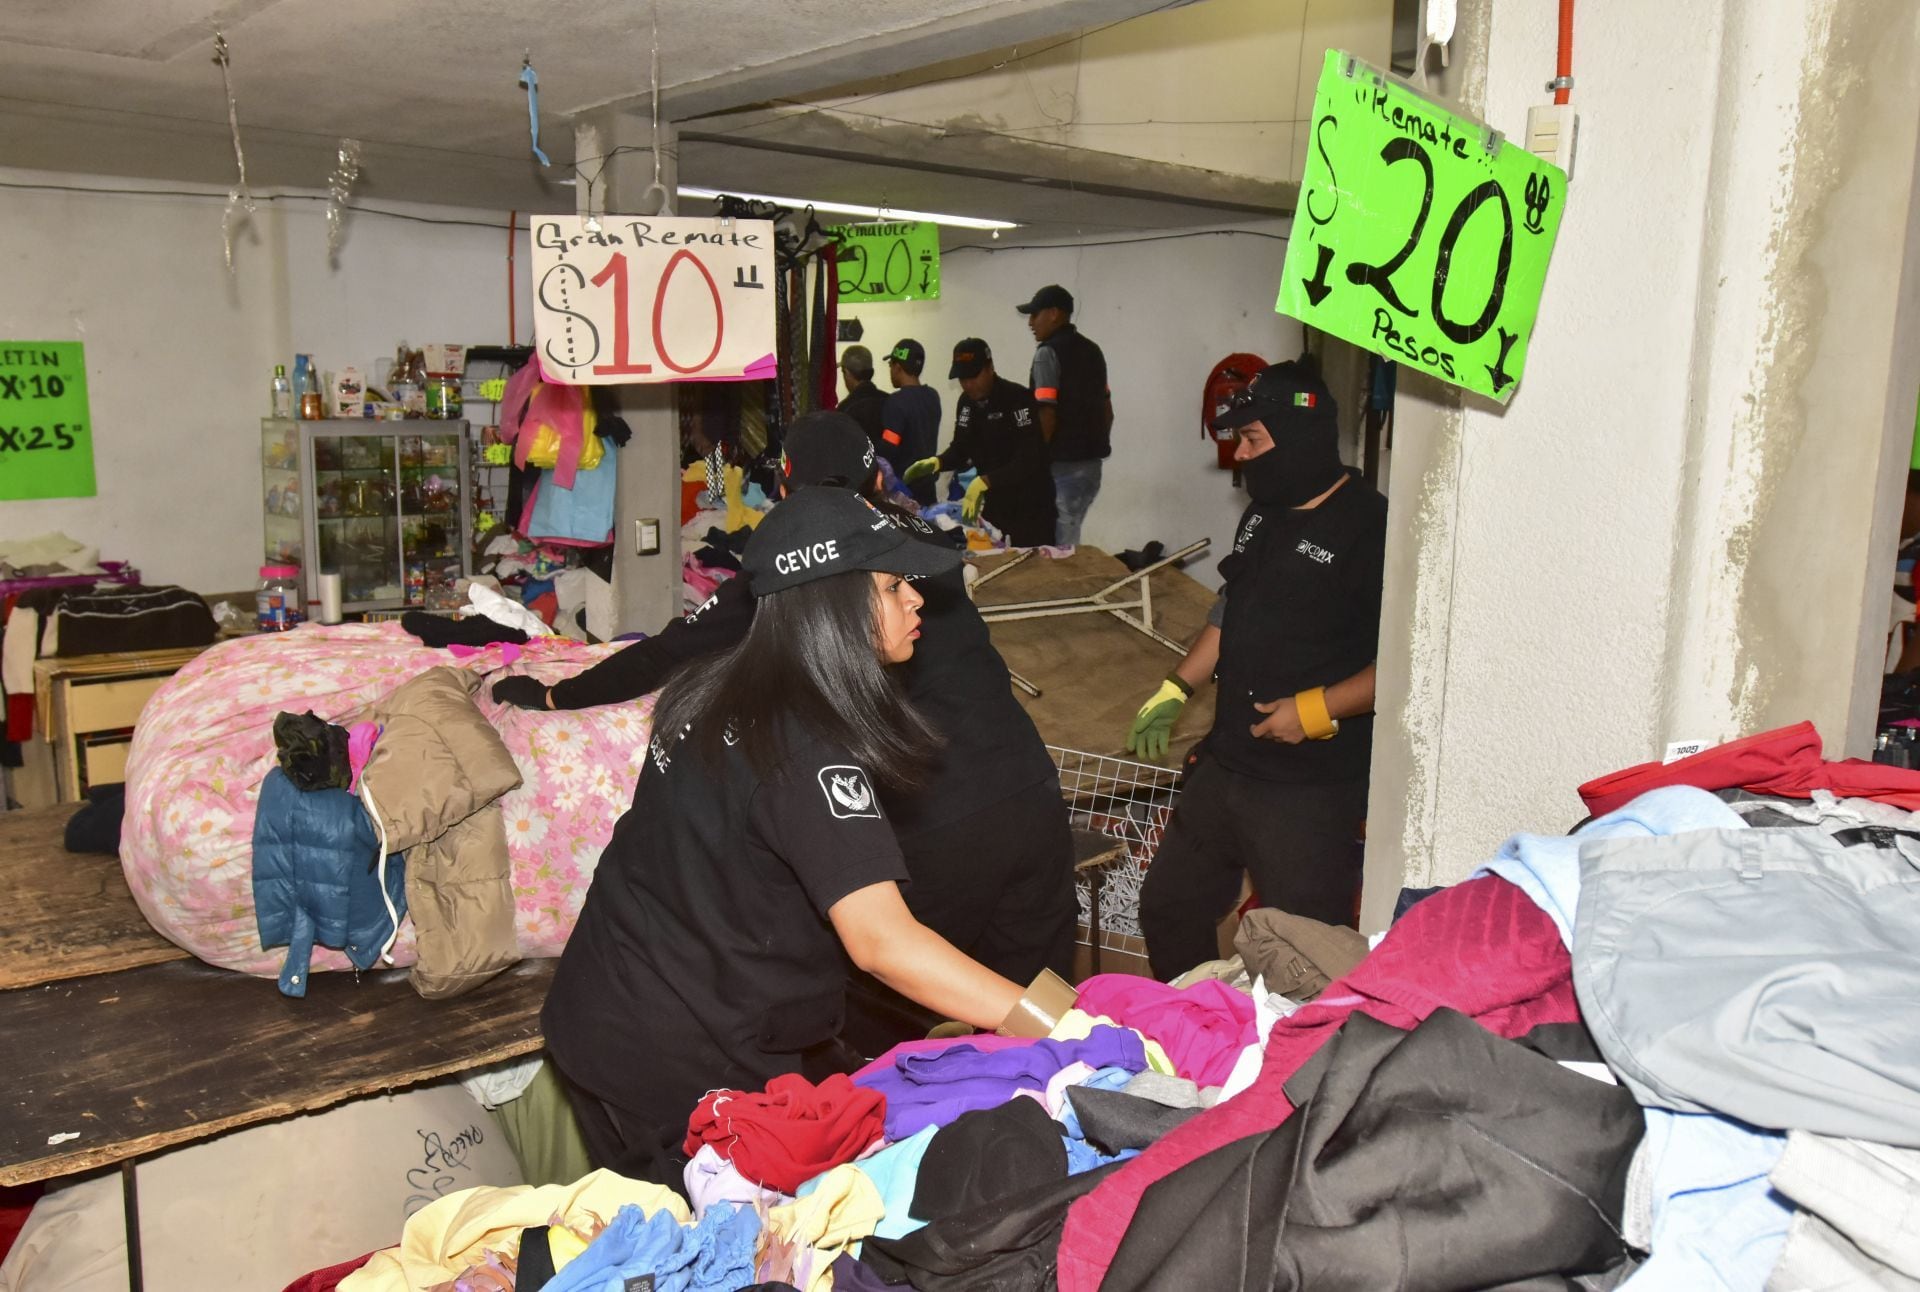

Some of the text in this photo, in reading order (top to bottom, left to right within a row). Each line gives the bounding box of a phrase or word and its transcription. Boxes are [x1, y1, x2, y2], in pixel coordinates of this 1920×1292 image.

[536, 222, 763, 252] Gran Remate
[0, 350, 59, 367] ETIN
[775, 540, 840, 575] CEVCE
[1308, 544, 1335, 564] CDMX
